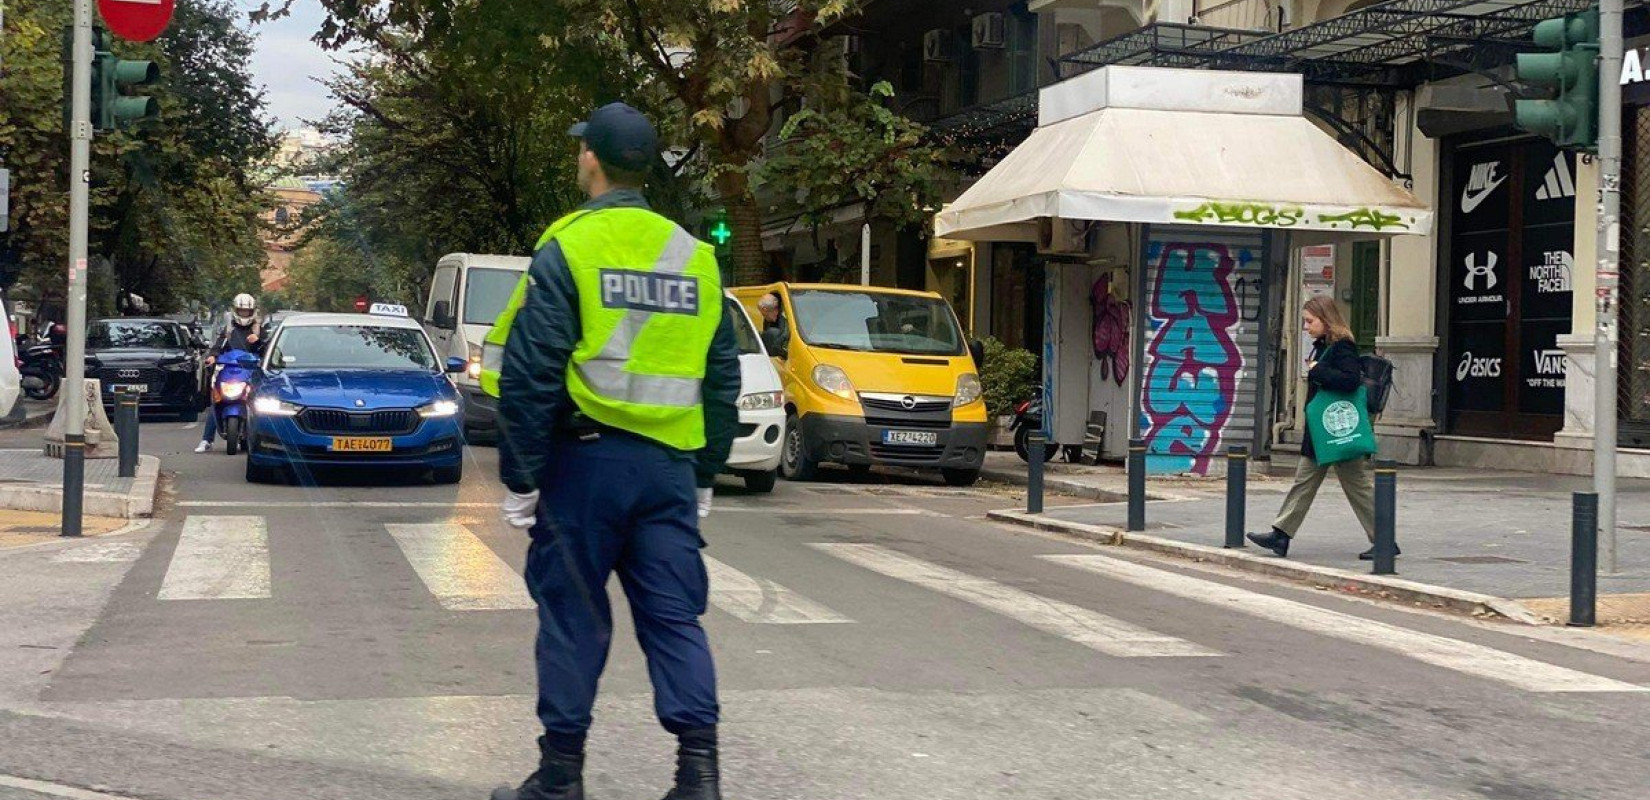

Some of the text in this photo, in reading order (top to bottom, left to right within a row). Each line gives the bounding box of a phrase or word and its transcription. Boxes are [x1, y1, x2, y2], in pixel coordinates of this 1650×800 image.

[1467, 161, 1501, 192] NIKE
[1543, 251, 1562, 265] THE
[1529, 265, 1562, 280] NORTH
[602, 273, 697, 310] POLICE
[1538, 279, 1563, 293] FACE
[1458, 294, 1503, 304] UNDER ARMOUR
[375, 304, 405, 314] TAXI
[1533, 349, 1567, 375] VANS
